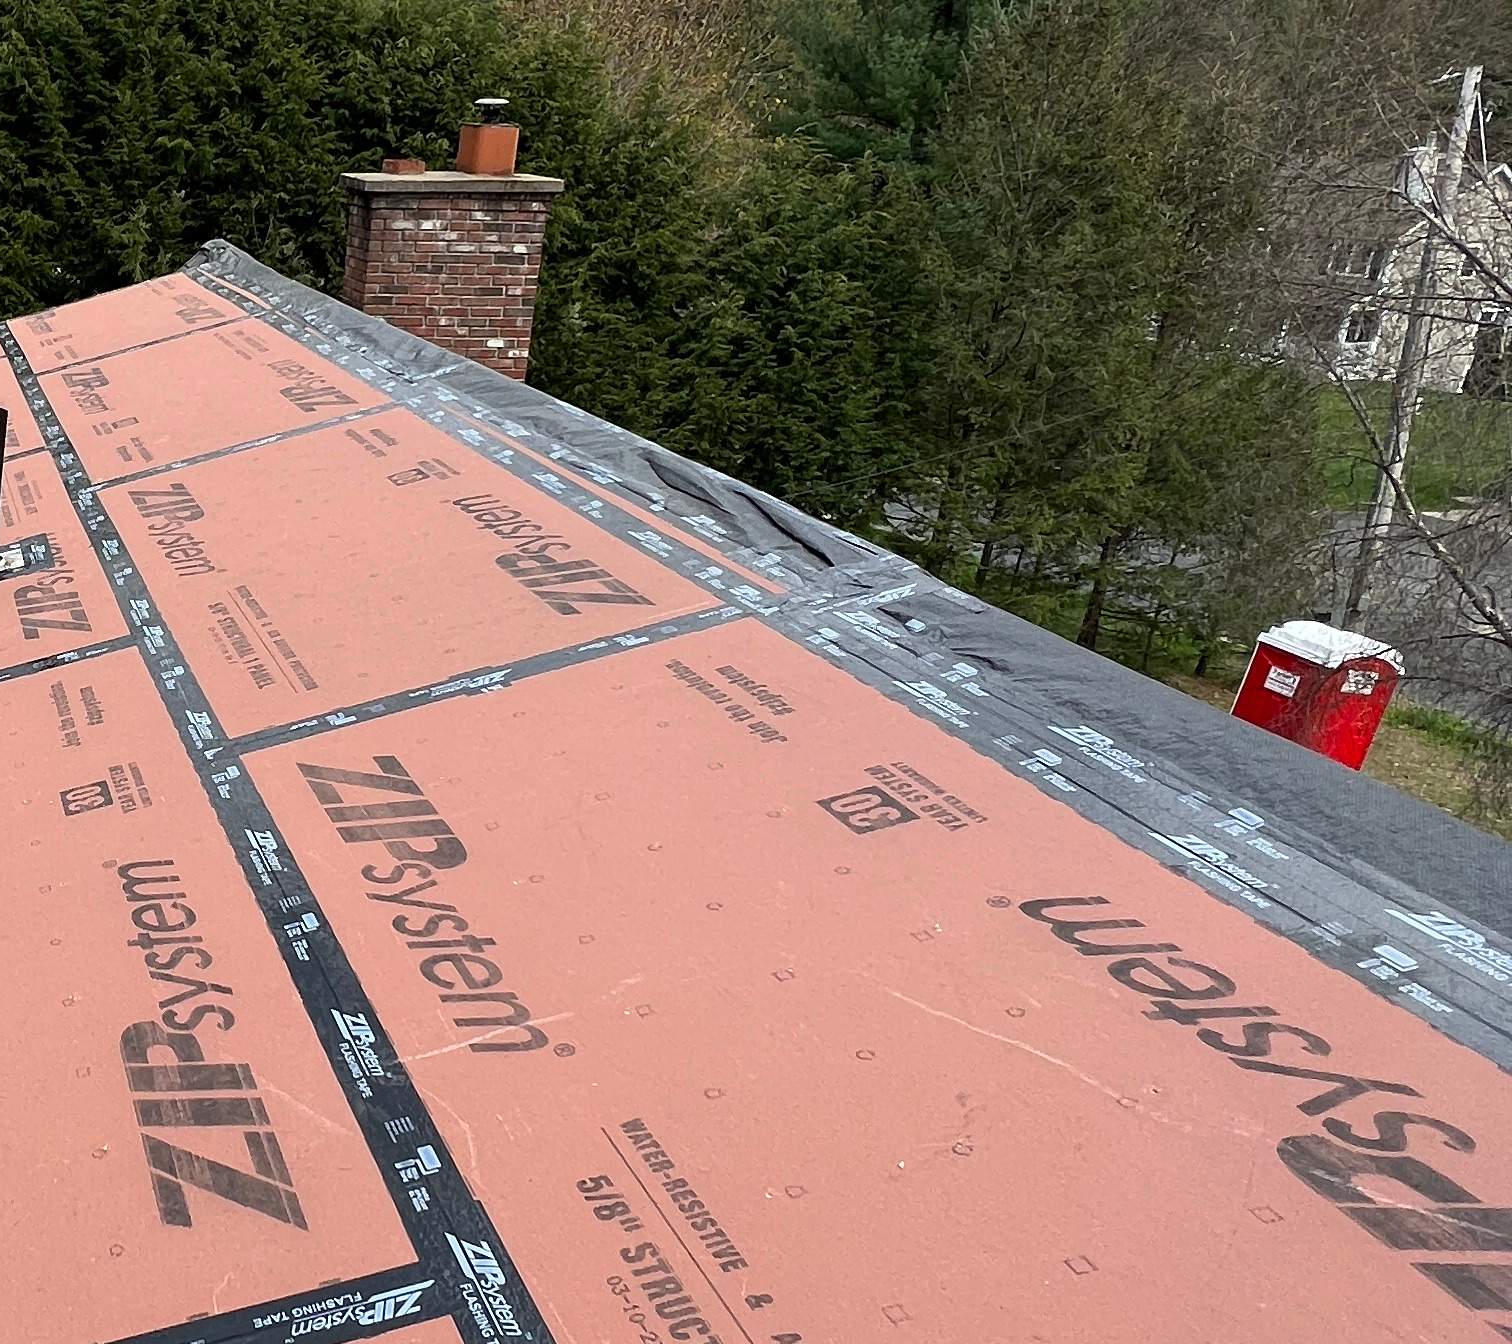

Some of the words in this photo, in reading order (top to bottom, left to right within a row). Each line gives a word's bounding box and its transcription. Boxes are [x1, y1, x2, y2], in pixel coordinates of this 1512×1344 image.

[864, 765, 928, 806] SYSTEM
[830, 792, 902, 827] 30
[929, 804, 968, 831] YEAR
[1438, 944, 1509, 981] FLASHING
[576, 1176, 643, 1237] 5/8"
[620, 1118, 749, 1274] WATER-RESISTIVE
[746, 1294, 772, 1311] &
[252, 1315, 290, 1329] TAPE
[291, 1291, 362, 1318] FLASHING
[460, 1283, 495, 1338] FLASHING
